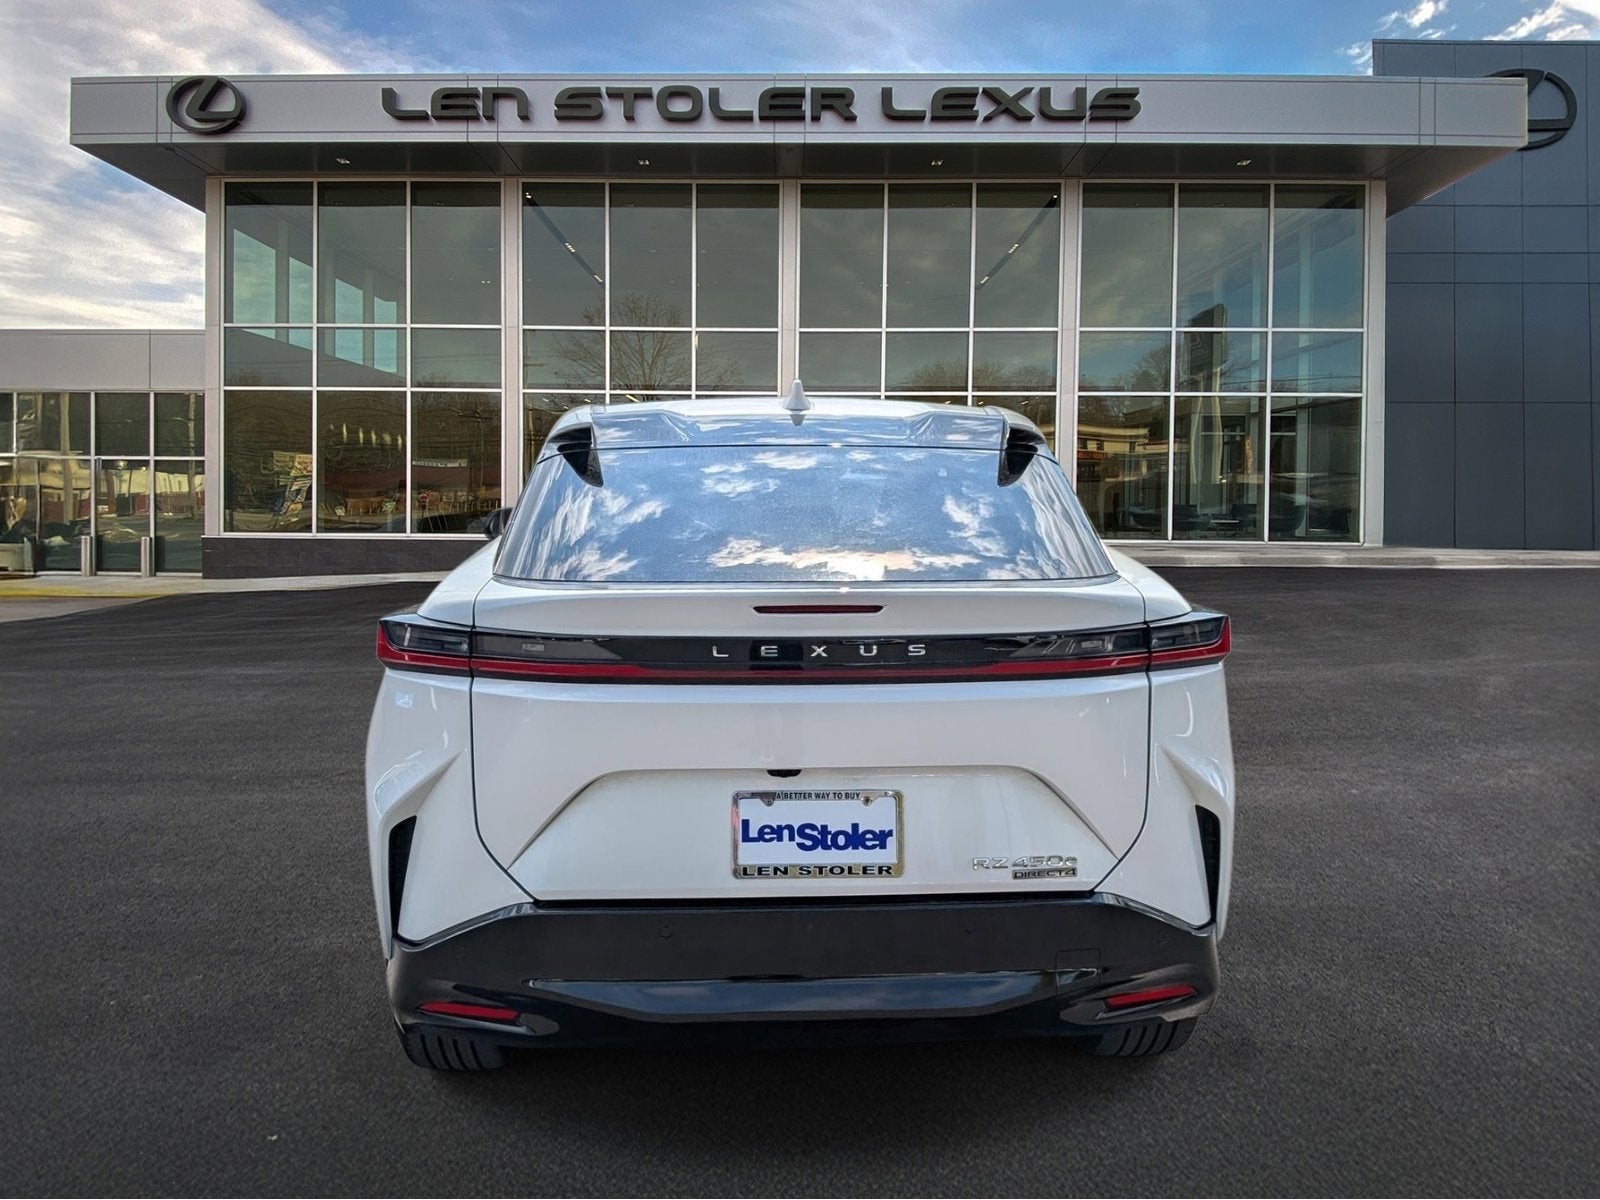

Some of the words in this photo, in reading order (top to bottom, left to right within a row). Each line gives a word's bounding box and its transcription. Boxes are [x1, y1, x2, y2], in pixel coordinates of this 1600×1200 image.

[381, 86, 530, 121] LEN
[554, 84, 857, 122] STOLER
[881, 86, 1142, 122] LEXUS
[711, 644, 927, 657] LEXUS
[784, 792, 813, 800] BETTER
[815, 792, 831, 800] WAY
[833, 792, 842, 800] TO
[845, 792, 860, 800] BUY
[972, 856, 1009, 870] RZ
[1012, 855, 1078, 868] 450e
[742, 866, 789, 876] LEN
[798, 865, 893, 876] STOLER
[1013, 868, 1077, 879] DIRECT4
